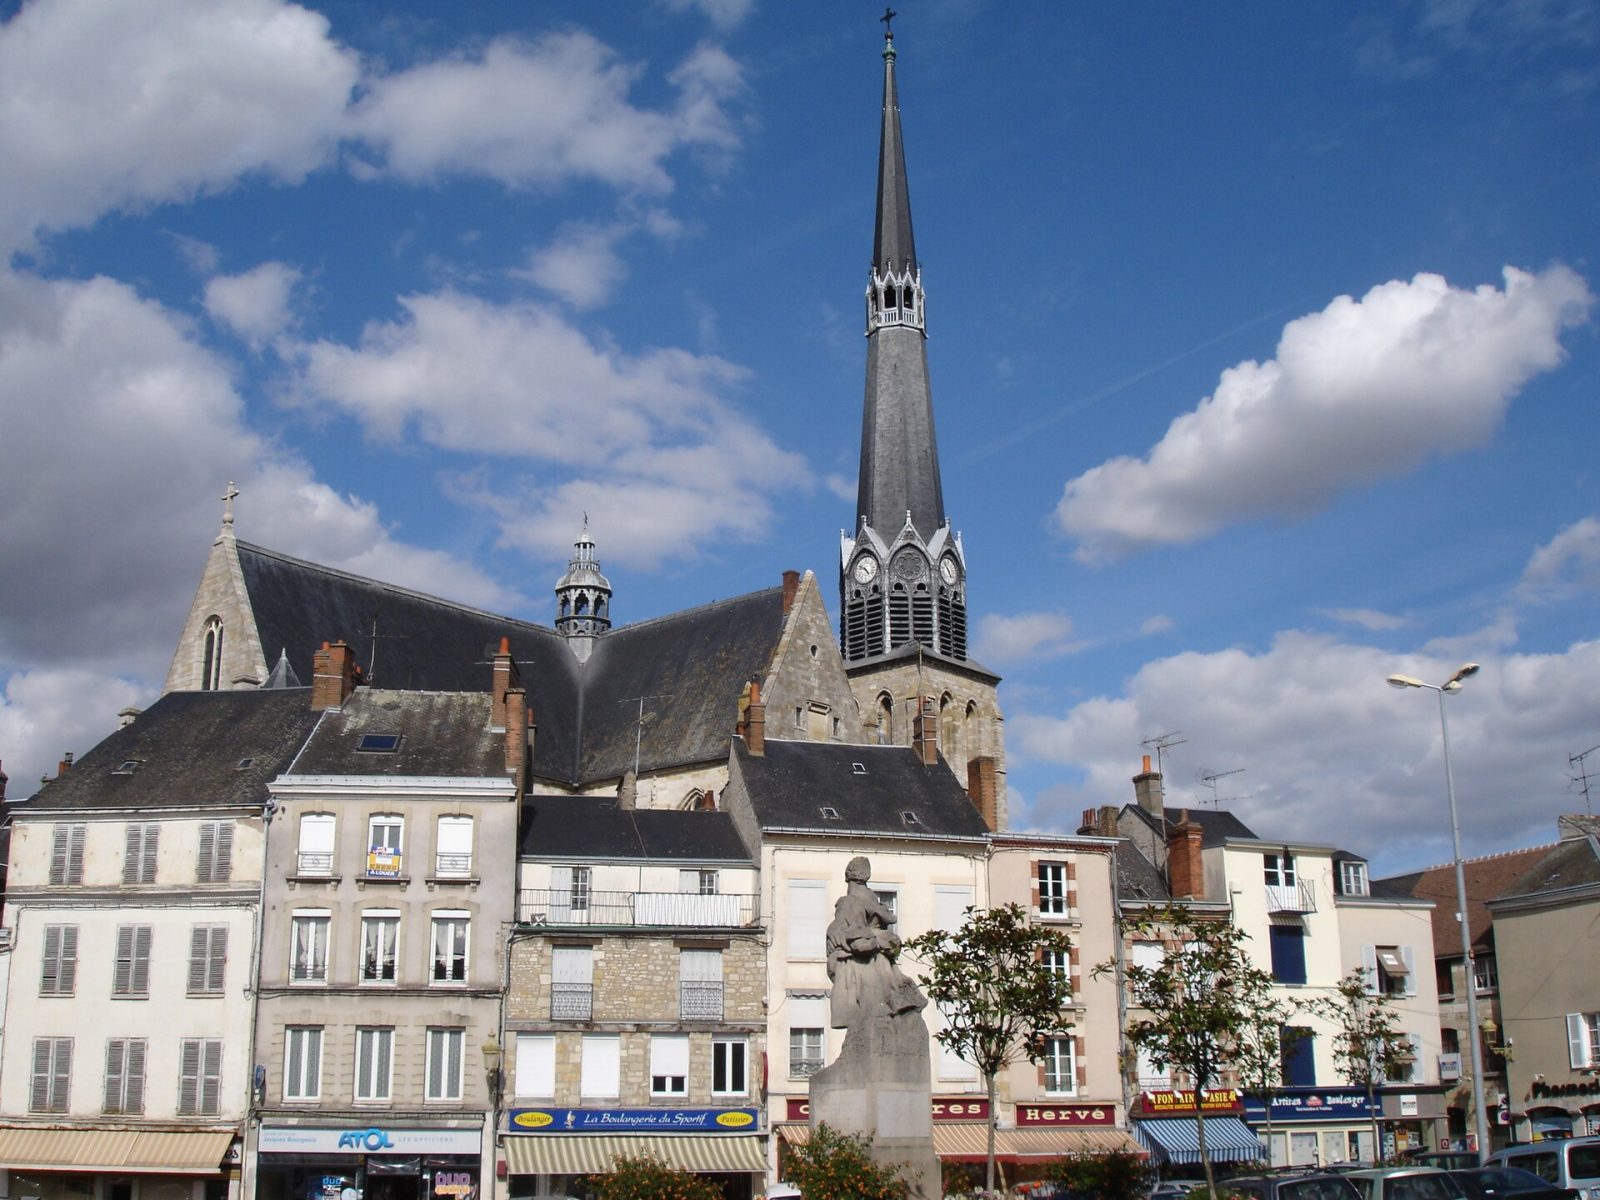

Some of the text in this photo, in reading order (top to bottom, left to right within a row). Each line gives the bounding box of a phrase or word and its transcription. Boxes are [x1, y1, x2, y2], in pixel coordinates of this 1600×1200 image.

[1272, 1094, 1365, 1108] Artisan Boulanger
[518, 1114, 551, 1125] Boulanger
[584, 1112, 708, 1126] La Boulangerie du Sportif
[1025, 1107, 1105, 1121] Hervé
[338, 1127, 395, 1151] ATOL
[435, 1172, 471, 1186] DUO
